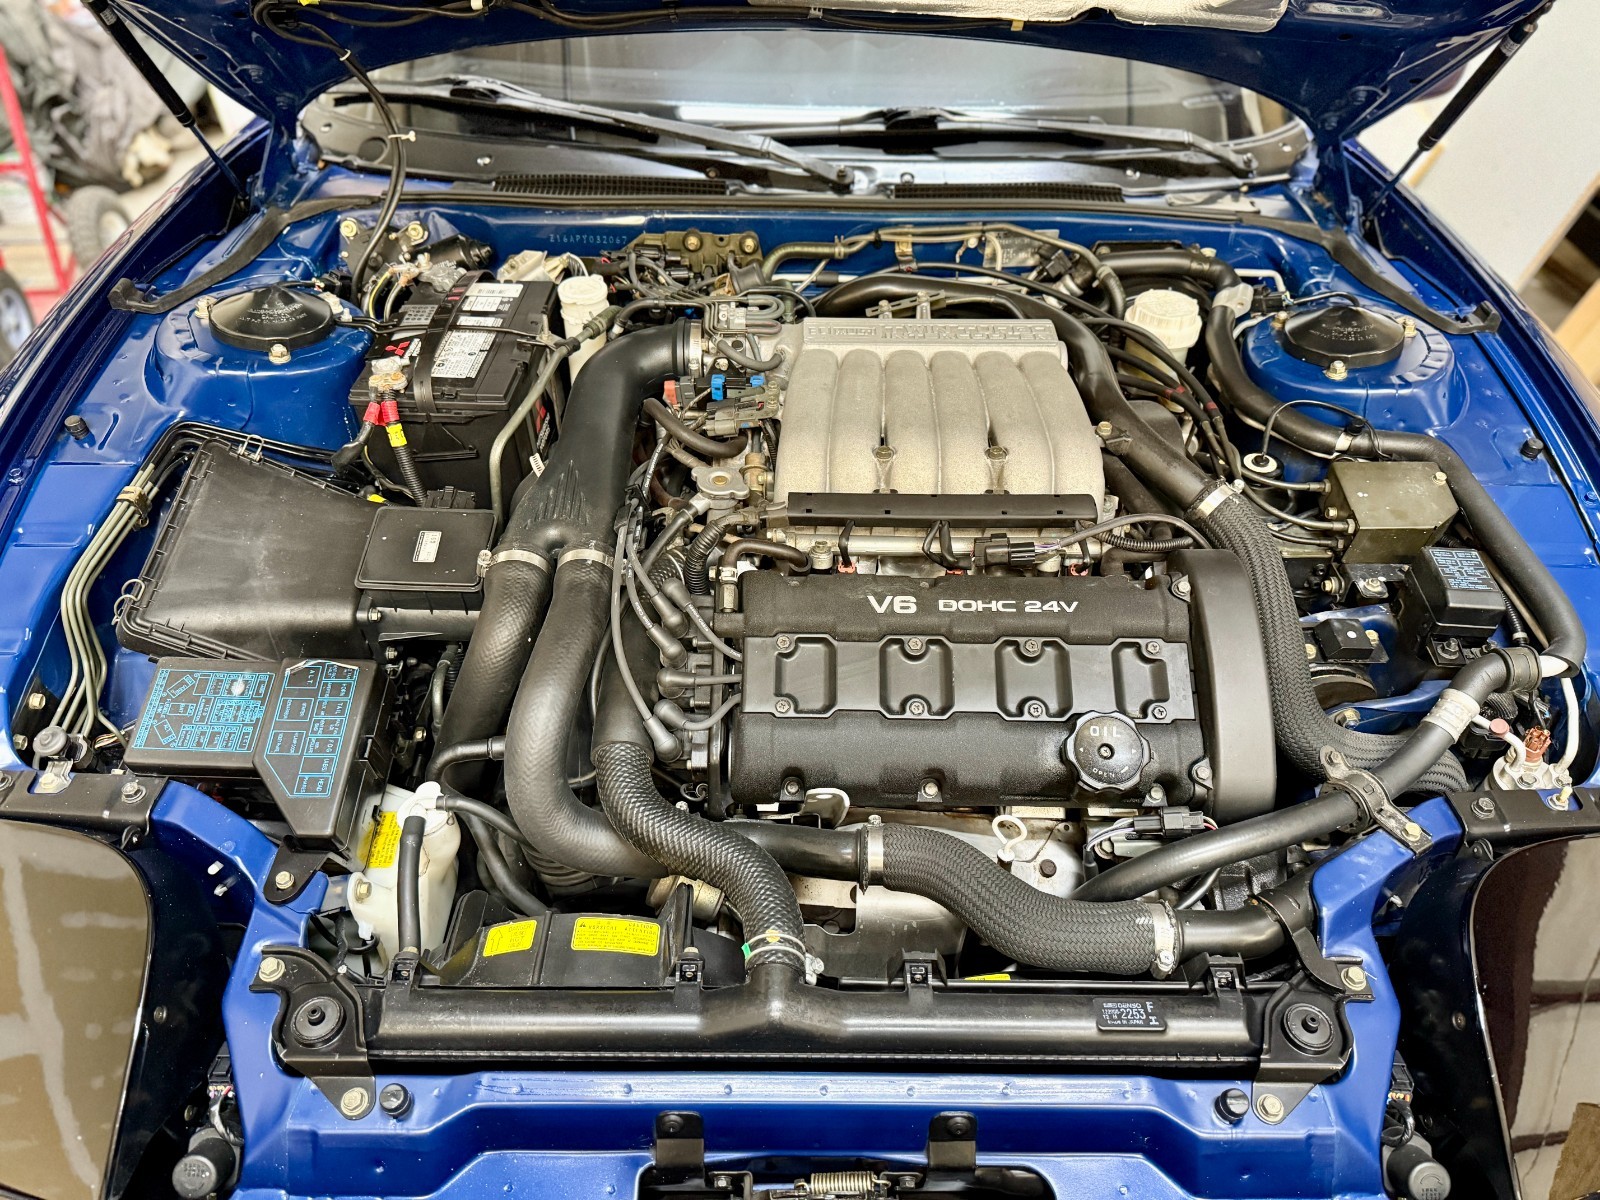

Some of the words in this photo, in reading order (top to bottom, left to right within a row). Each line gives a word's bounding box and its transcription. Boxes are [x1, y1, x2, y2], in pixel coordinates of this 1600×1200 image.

[867, 595, 917, 614] V6
[938, 599, 1017, 612] DOHC
[1024, 600, 1079, 613] 24V
[1090, 725, 1121, 738] OIL
[1092, 767, 1115, 778] OPEN
